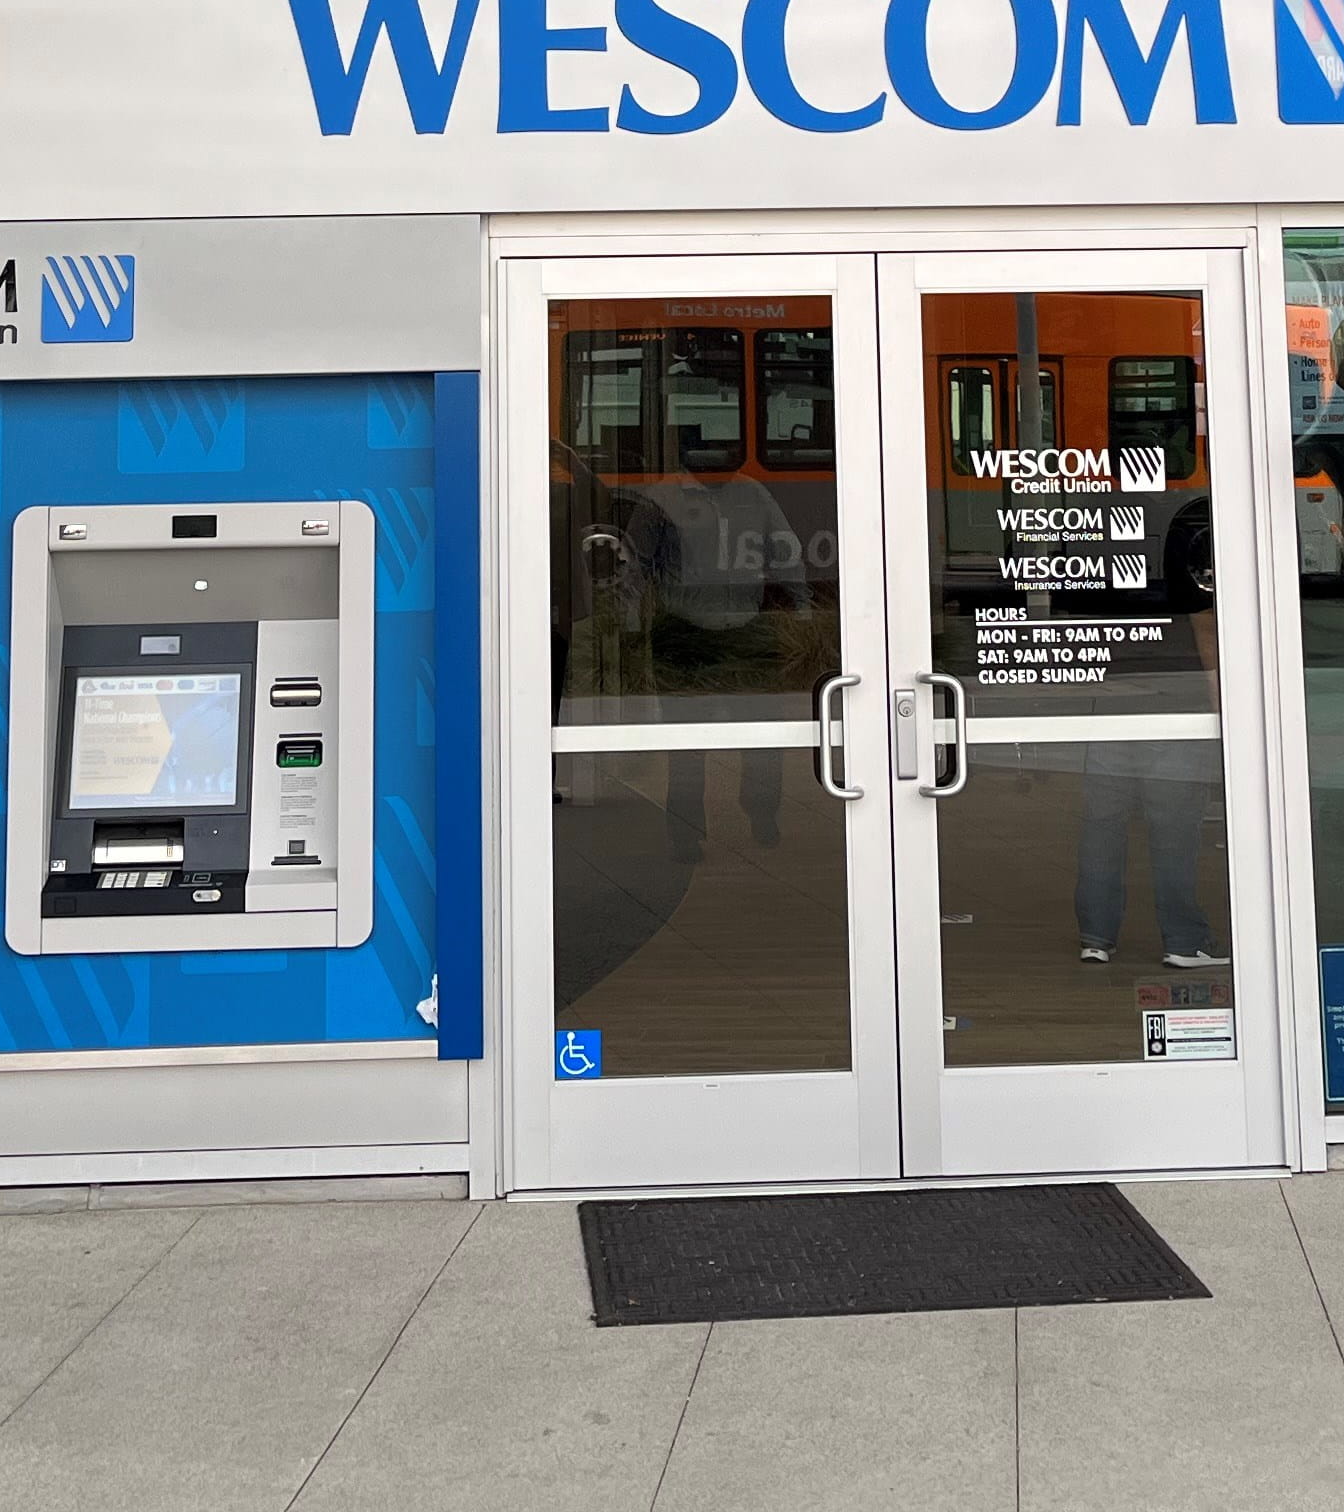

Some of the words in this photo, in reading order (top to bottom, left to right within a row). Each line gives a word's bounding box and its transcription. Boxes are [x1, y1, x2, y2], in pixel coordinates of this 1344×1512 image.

[1299, 319, 1321, 330] Auto
[1300, 336, 1329, 348] Person
[1301, 356, 1327, 368] Home
[1301, 371, 1326, 382] Lines
[970, 448, 1111, 479] WESCOM
[1011, 479, 1060, 494] Credit
[1063, 478, 1111, 493] Union
[996, 508, 1103, 531] WESCOM
[1016, 532, 1060, 542] Financial
[1062, 531, 1104, 541] Services
[998, 556, 1105, 579] WESCOM
[1014, 580, 1062, 591] Insurance
[1064, 580, 1106, 590] Services
[975, 608, 1027, 622] HOURS
[977, 629, 1016, 644] MON
[1033, 628, 1061, 643] FRI:
[1066, 627, 1100, 642] 9AM
[1104, 627, 1124, 641] TO
[1129, 627, 1163, 641] 6PM
[978, 649, 1009, 664] SAT:
[1013, 648, 1048, 663] 9AM
[1052, 648, 1073, 662] TO
[1077, 647, 1111, 662] 4PM
[978, 669, 1037, 684] CLOSED
[1042, 668, 1106, 683] SUNDAY
[1147, 1016, 1165, 1040] FBI
